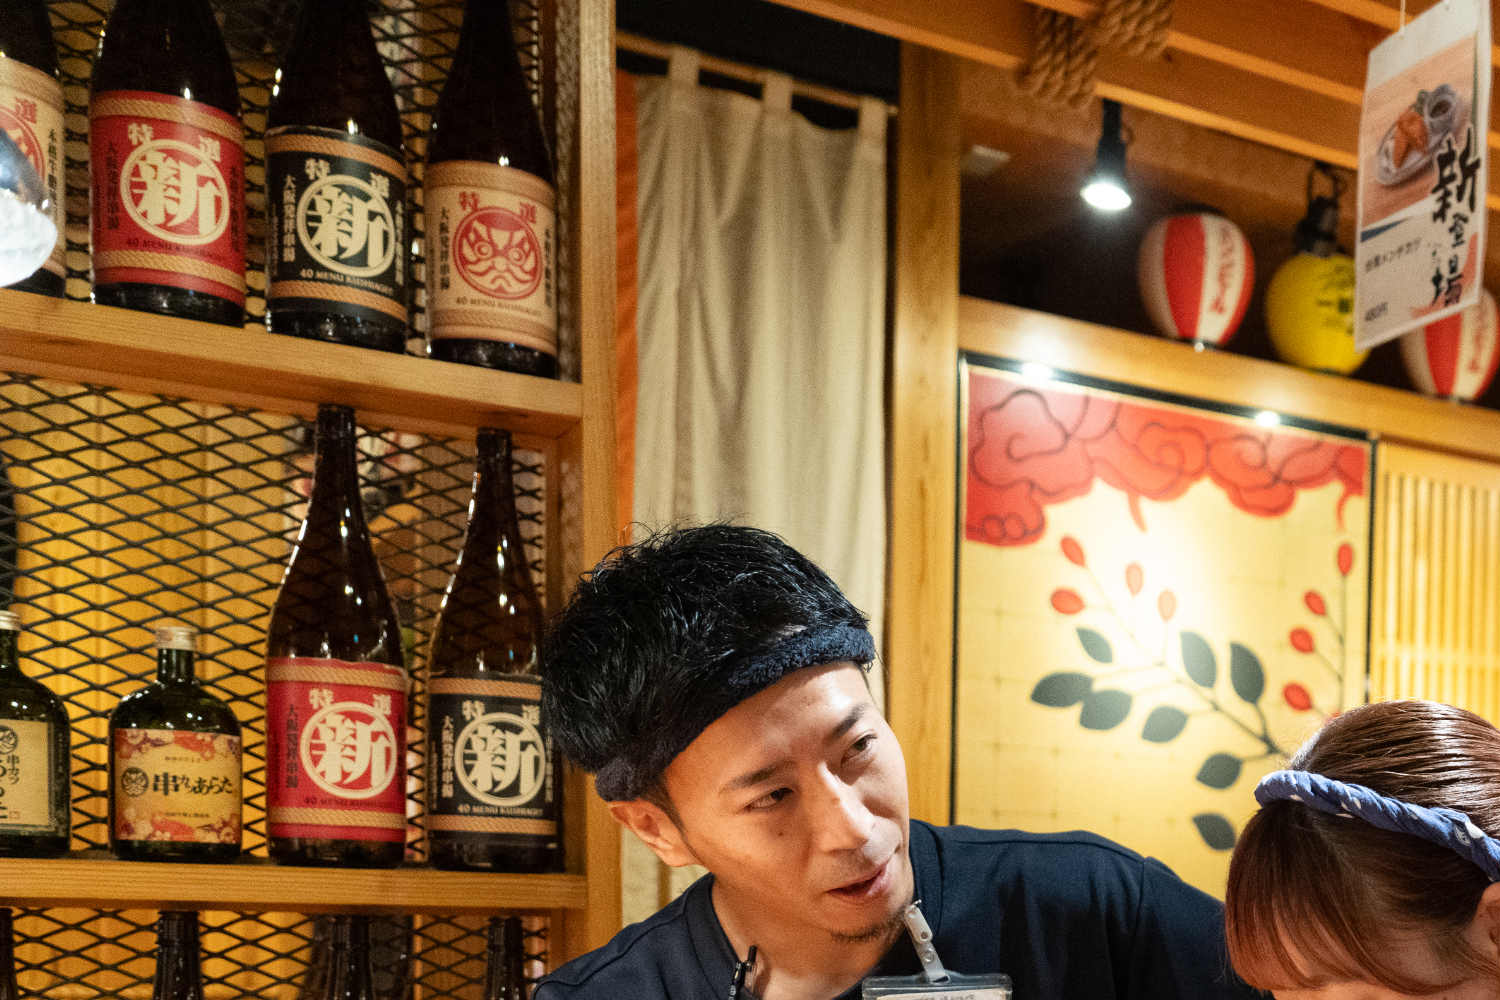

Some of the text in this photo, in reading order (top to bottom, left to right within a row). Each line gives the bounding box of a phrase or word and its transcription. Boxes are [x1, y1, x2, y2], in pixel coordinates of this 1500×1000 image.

[128, 149, 223, 238] 新
[304, 184, 391, 268] 新
[153, 771, 233, 796] 串カツあらた
[310, 711, 392, 785] 新
[463, 721, 542, 799] 新
